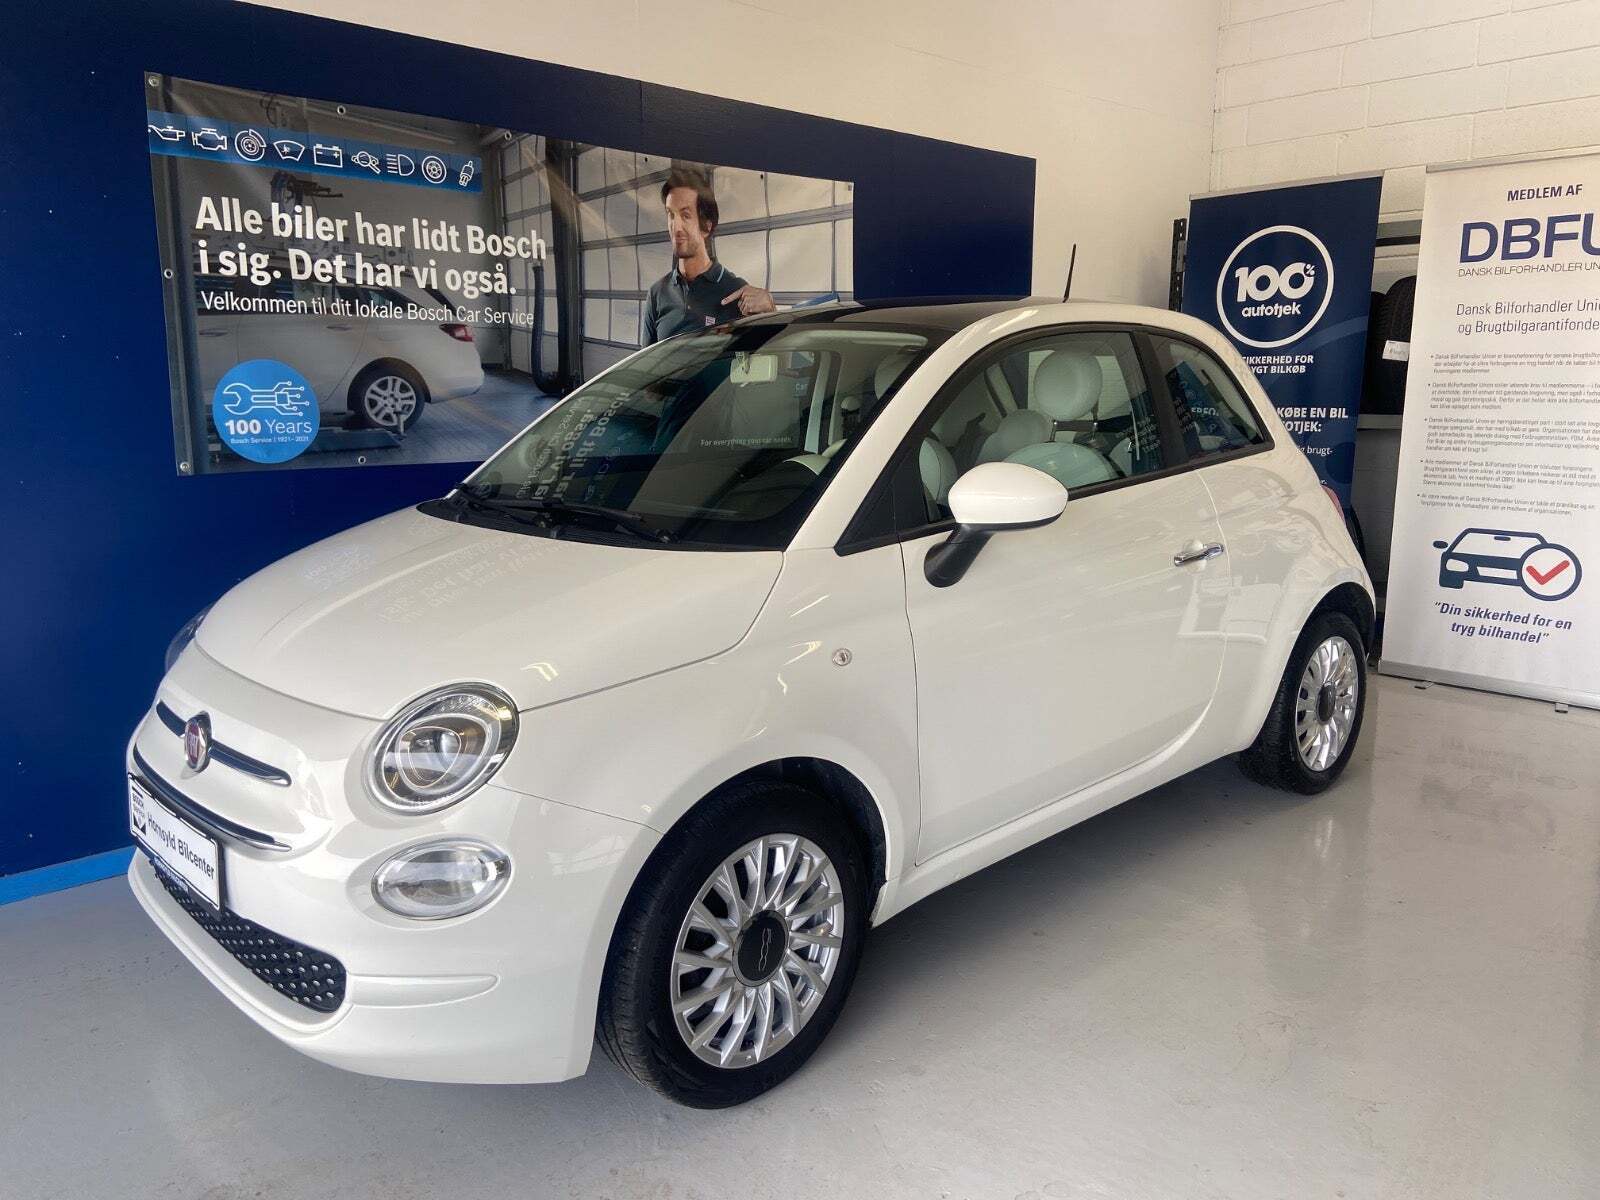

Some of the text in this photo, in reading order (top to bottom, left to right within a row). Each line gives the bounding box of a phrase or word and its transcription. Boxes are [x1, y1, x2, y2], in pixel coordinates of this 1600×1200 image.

[1507, 184, 1583, 202] MEDLEM AF
[195, 196, 547, 260] Alle biler har lidt Bosch
[198, 239, 517, 300] i sig. Det har vi også.
[1458, 267, 1492, 277] DANSK
[1495, 263, 1582, 275] BILFORHANDLER
[200, 290, 535, 326] Velkommen til dit lokale Bosch Car Service
[1242, 302, 1302, 318] autotjek
[1456, 303, 1491, 316] Dansk
[1495, 300, 1572, 314] Bilforhandler
[1458, 323, 1472, 335] og
[1294, 355, 1314, 364] FOR
[1249, 365, 1306, 374] YGT BILKØB
[1276, 407, 1349, 419] KØBE EN BIL
[225, 418, 313, 435] 100 Years
[1282, 420, 1322, 434] OTJEK:
[1306, 445, 1334, 456] brugt-
[1464, 606, 1532, 624] sikkerhed
[1532, 615, 1552, 627] for
[1555, 619, 1572, 630] en
[1451, 622, 1550, 644] tryg bilhandel”
[147, 811, 177, 850] Hornsyld
[177, 838, 215, 880] Bilcenter
